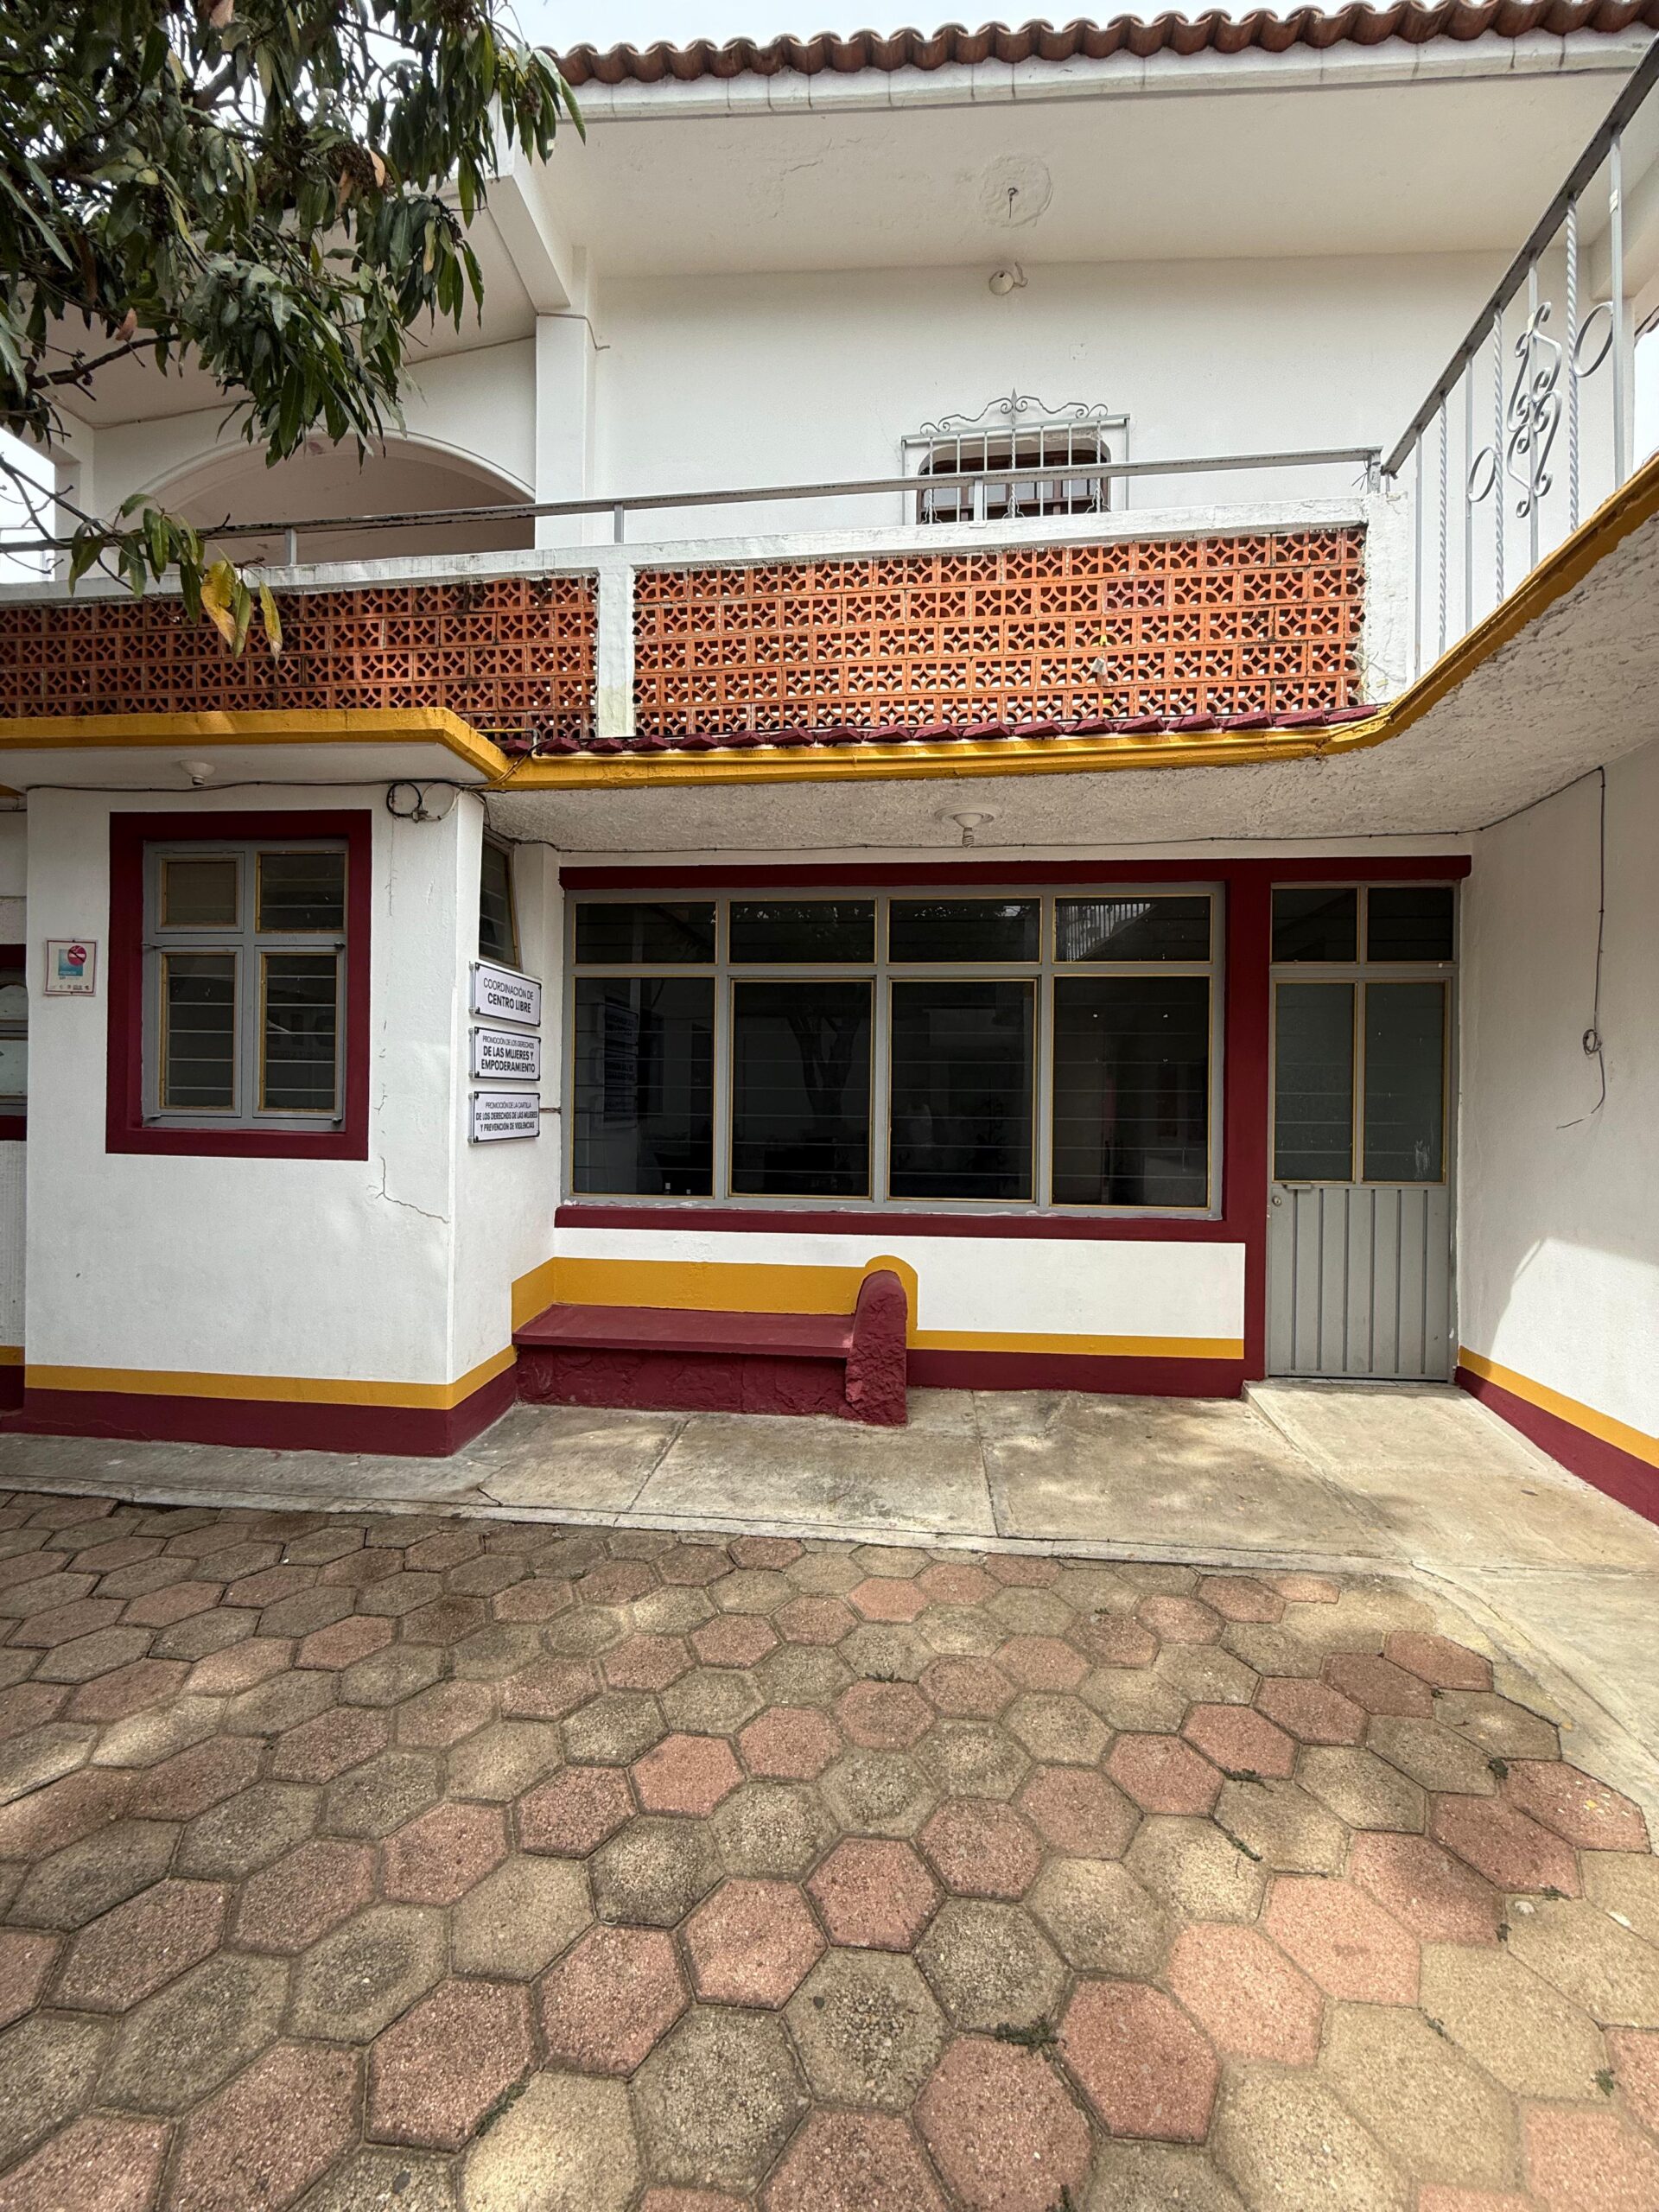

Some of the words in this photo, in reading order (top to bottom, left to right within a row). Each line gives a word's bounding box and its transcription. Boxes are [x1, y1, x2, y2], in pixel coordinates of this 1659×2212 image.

[484, 978, 526, 998] COORDINACIÓN
[527, 990, 533, 1000] DE
[488, 992, 514, 1009] CENTRO
[516, 1000, 531, 1013] LIBRE
[484, 1046, 491, 1056] DE
[493, 1047, 504, 1057] LAS
[505, 1048, 529, 1060] MUJERES
[530, 1051, 533, 1060] Y
[482, 1059, 535, 1073] EMPODERAMIENTO
